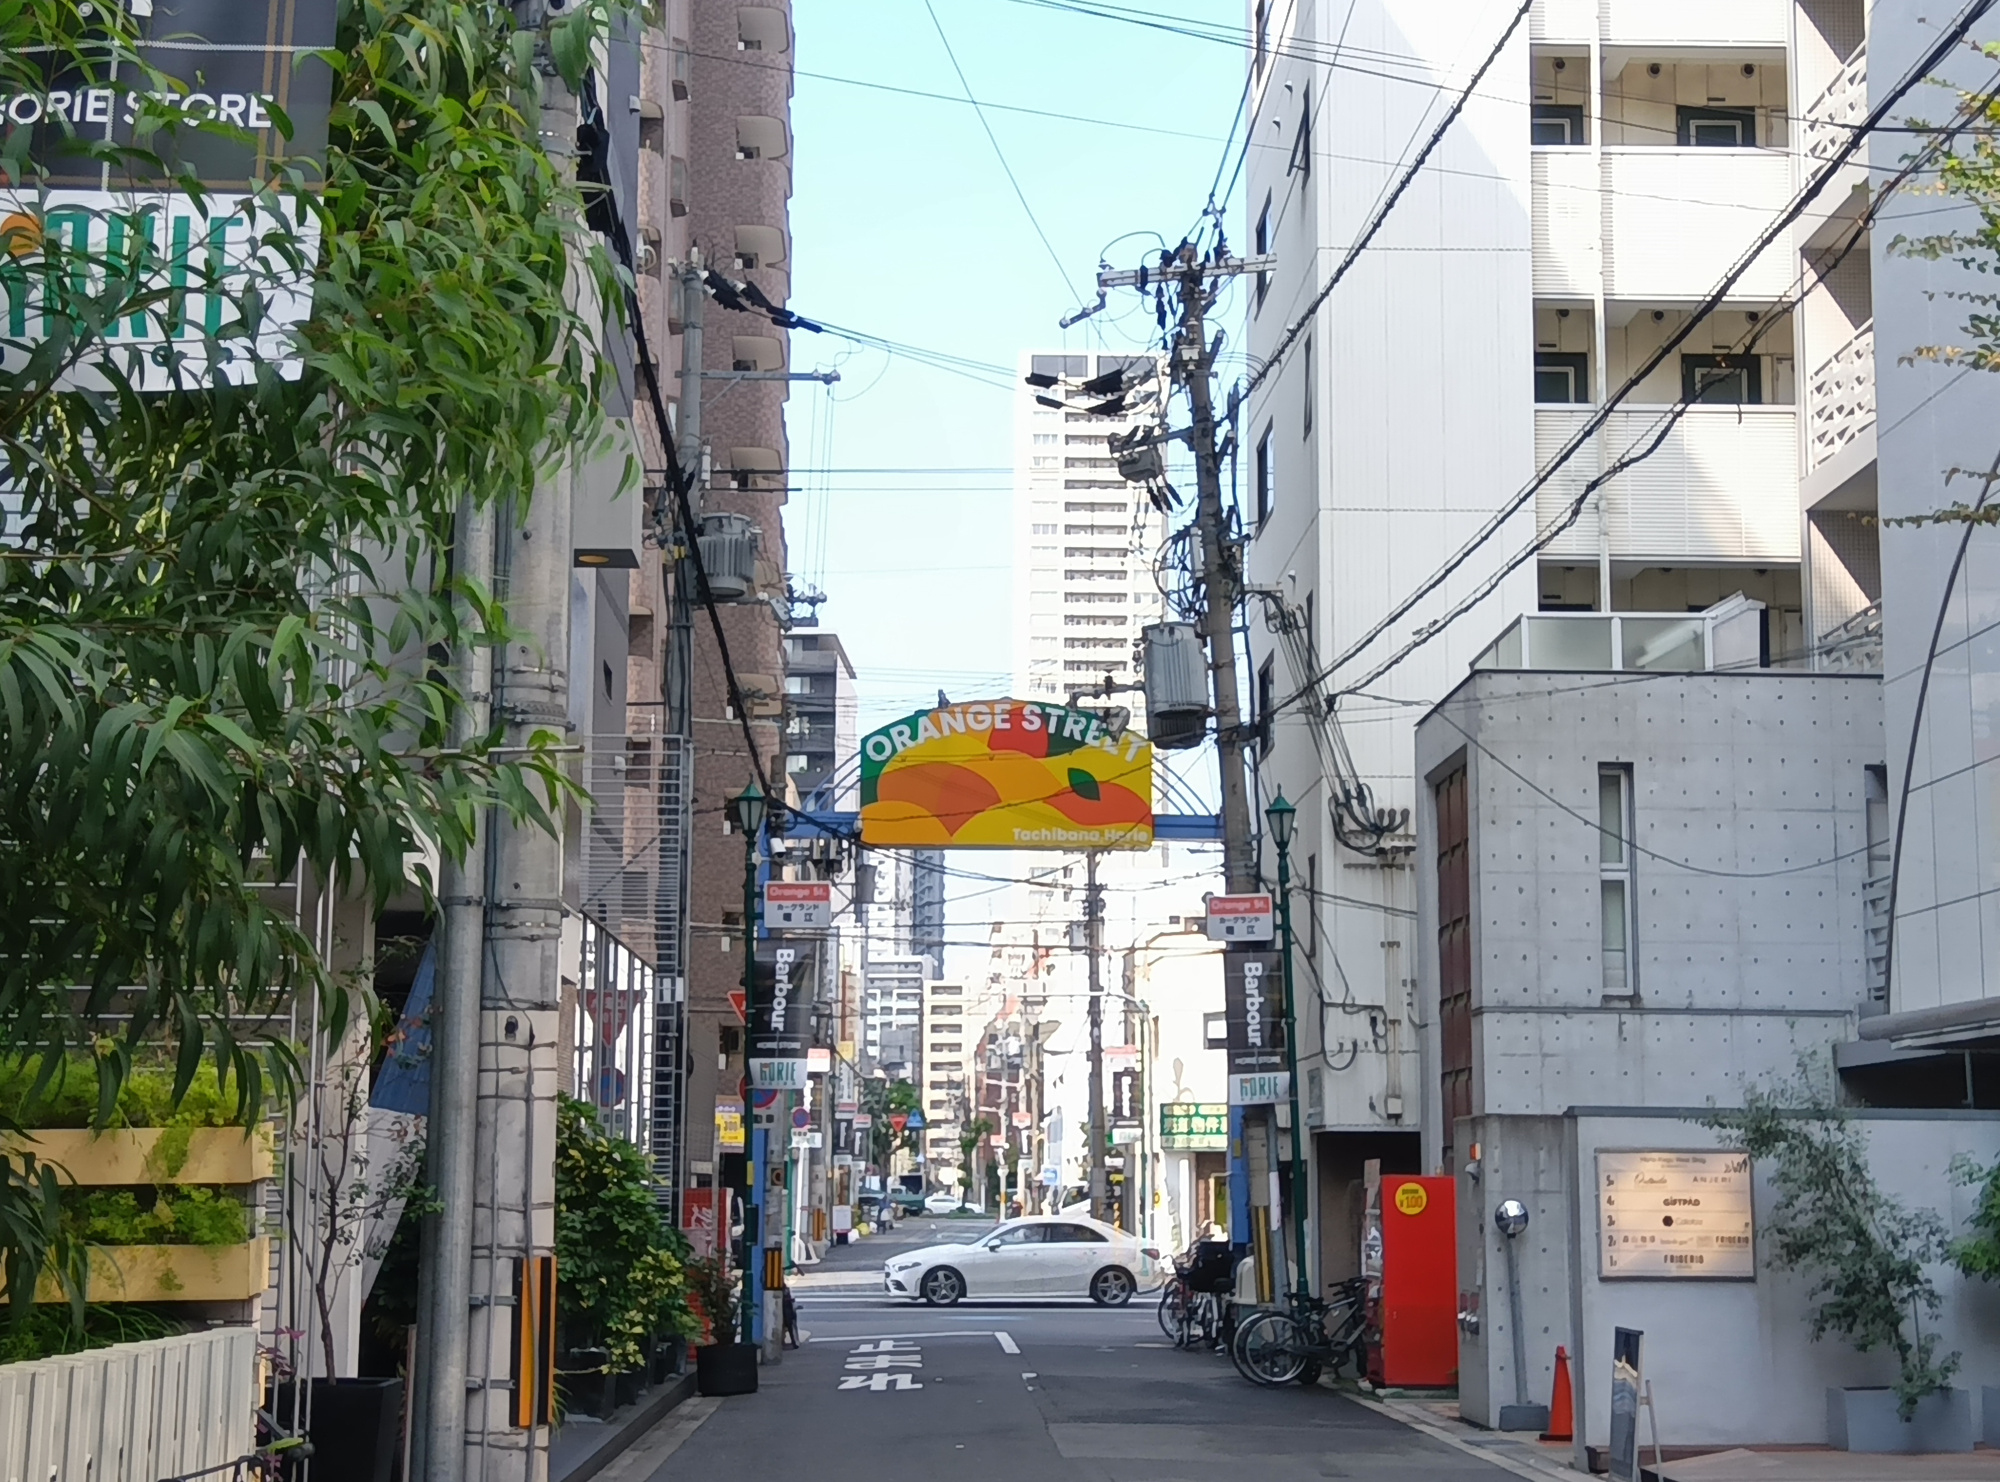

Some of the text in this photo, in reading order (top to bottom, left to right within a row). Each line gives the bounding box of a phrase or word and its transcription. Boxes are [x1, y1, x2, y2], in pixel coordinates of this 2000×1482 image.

[0, 89, 110, 125] ORIE
[866, 703, 1011, 762] ORANGE
[1012, 827, 1100, 841] Tachibana
[771, 948, 795, 1032] Barbour
[1243, 961, 1265, 1047] Barbour
[837, 1340, 924, 1391] 止まれ
